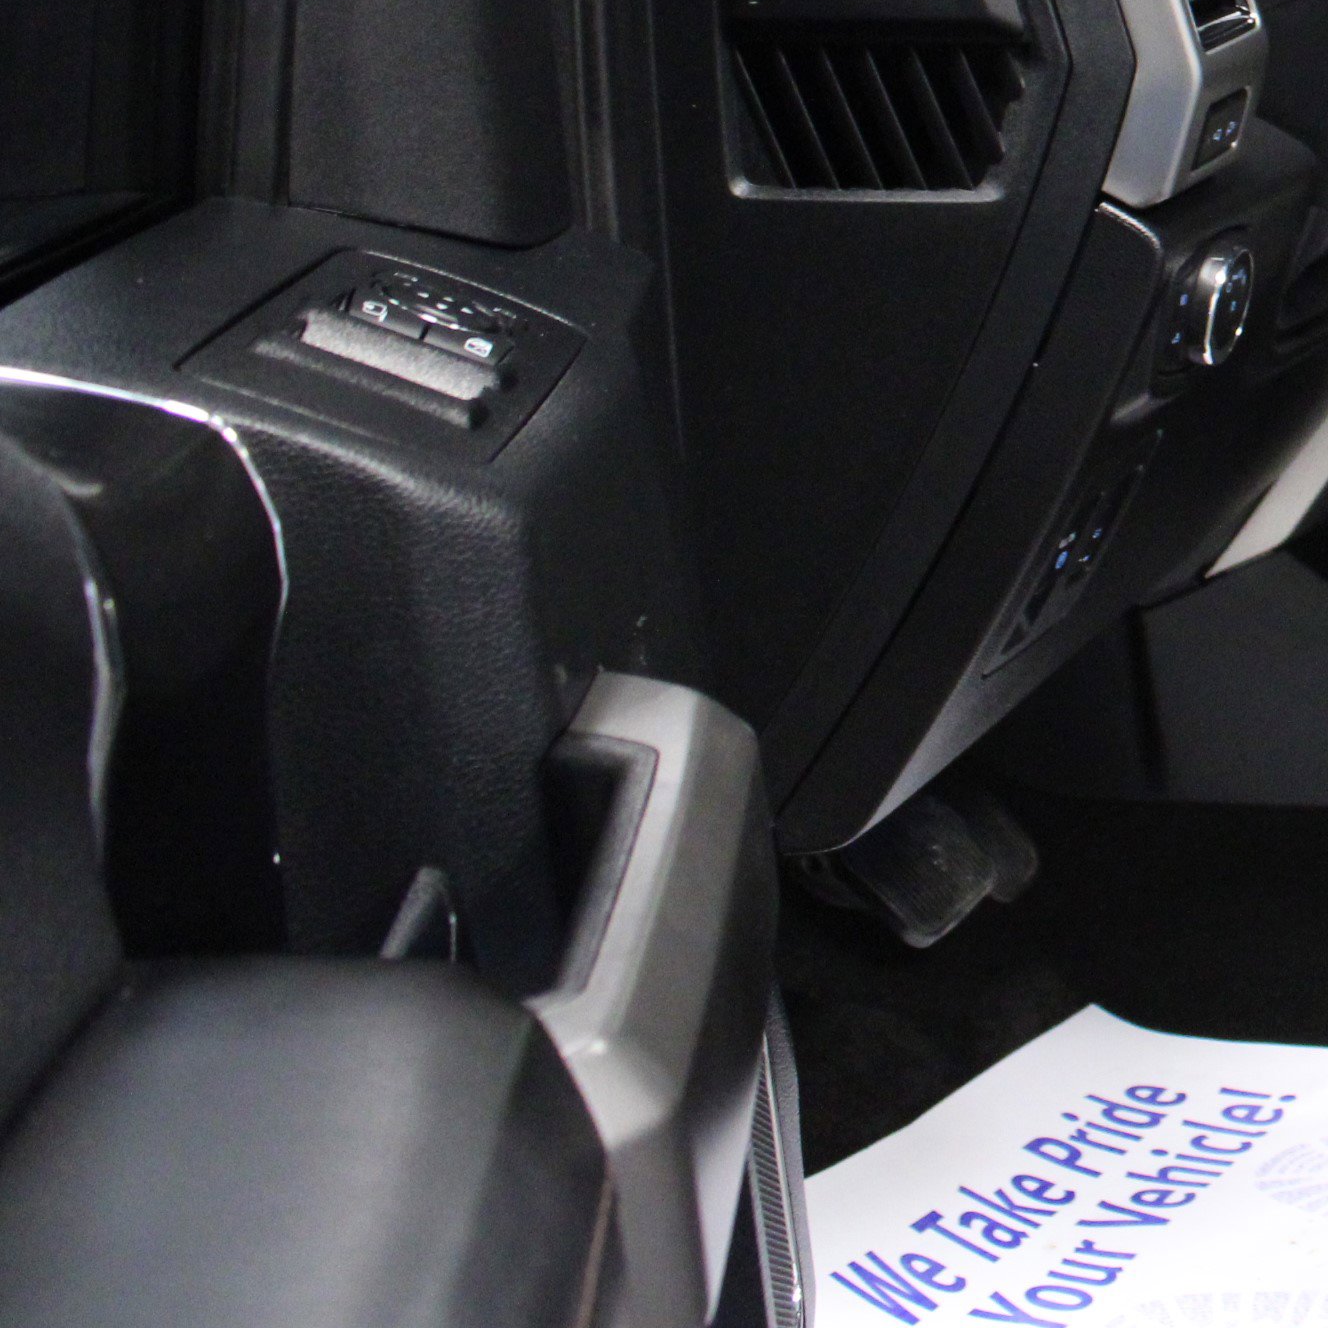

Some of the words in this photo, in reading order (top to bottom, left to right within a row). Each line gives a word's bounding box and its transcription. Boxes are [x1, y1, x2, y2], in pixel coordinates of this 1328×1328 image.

[828, 1249, 968, 1326] We
[909, 1173, 1077, 1263] Take
[1021, 1083, 1188, 1178] Pride
[968, 1238, 1138, 1328] Your
[1074, 1085, 1298, 1227] Vehicle!
